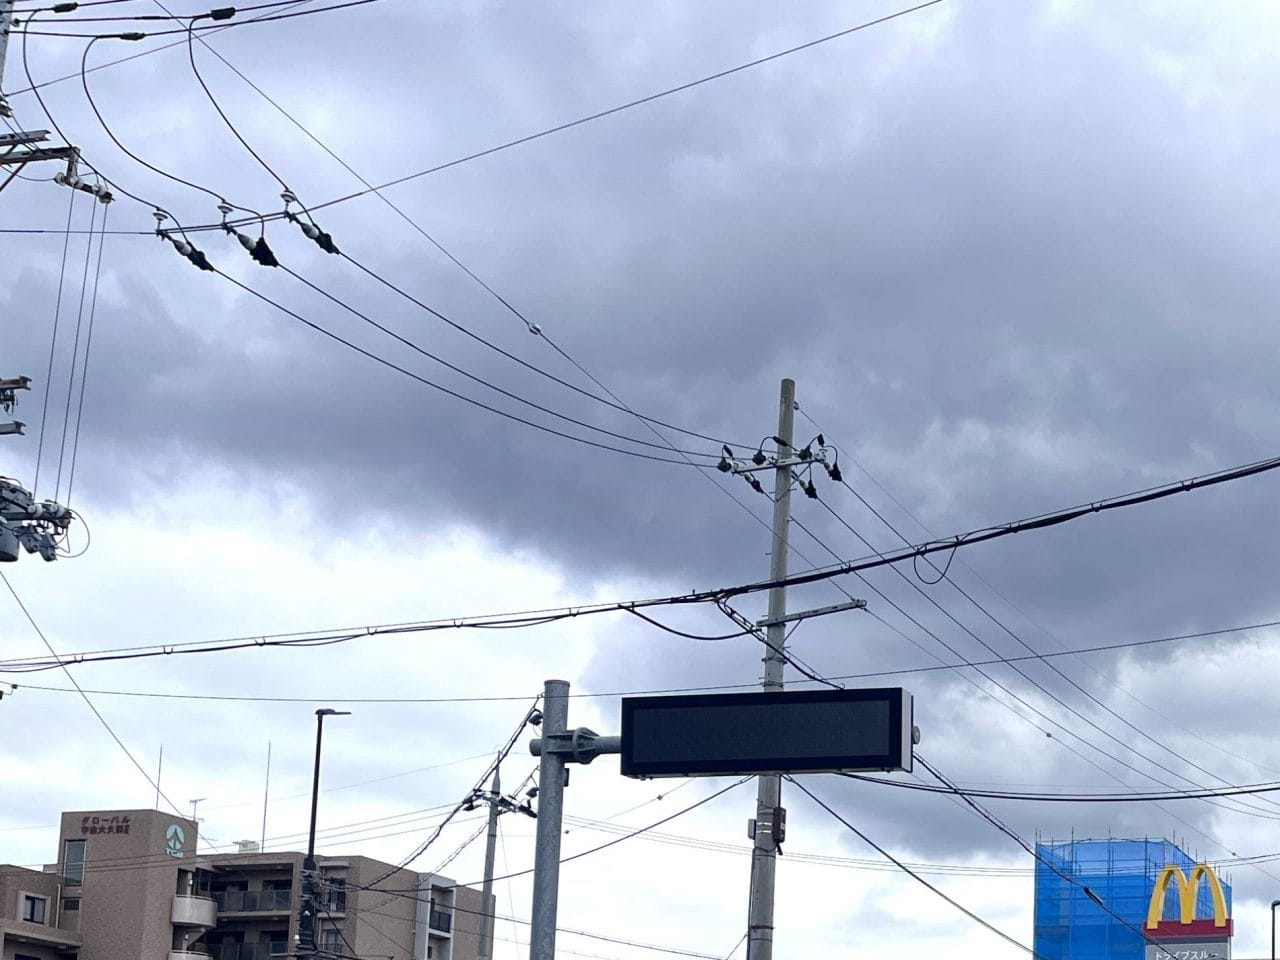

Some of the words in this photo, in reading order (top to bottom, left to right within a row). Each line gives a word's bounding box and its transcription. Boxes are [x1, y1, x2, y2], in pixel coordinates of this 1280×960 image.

[1155, 950, 1219, 960] ドライブスルー
